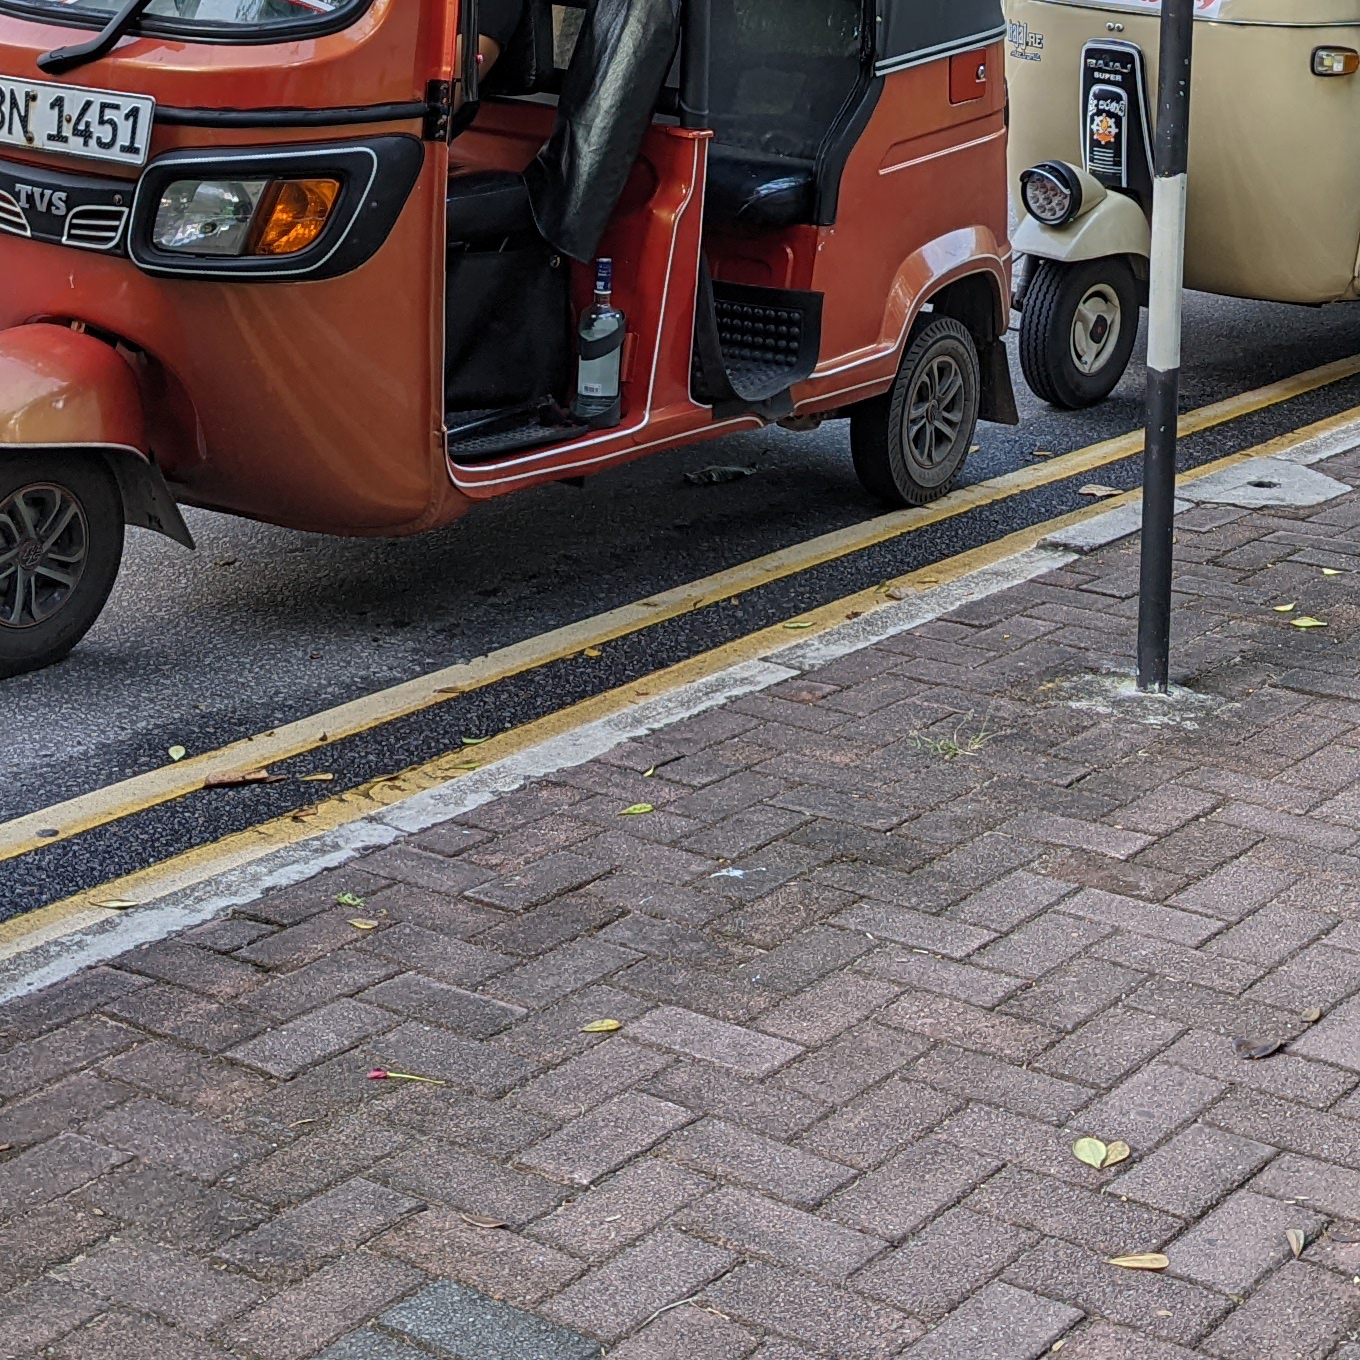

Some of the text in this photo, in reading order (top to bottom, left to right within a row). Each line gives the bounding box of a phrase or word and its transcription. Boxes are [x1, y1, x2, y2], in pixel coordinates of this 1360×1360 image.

[1028, 31, 1044, 50] RE
[1086, 58, 1132, 73] BAJAJ
[1093, 71, 1123, 82] SUPER
[46, 94, 142, 156] 1451
[14, 183, 68, 216] TVS
